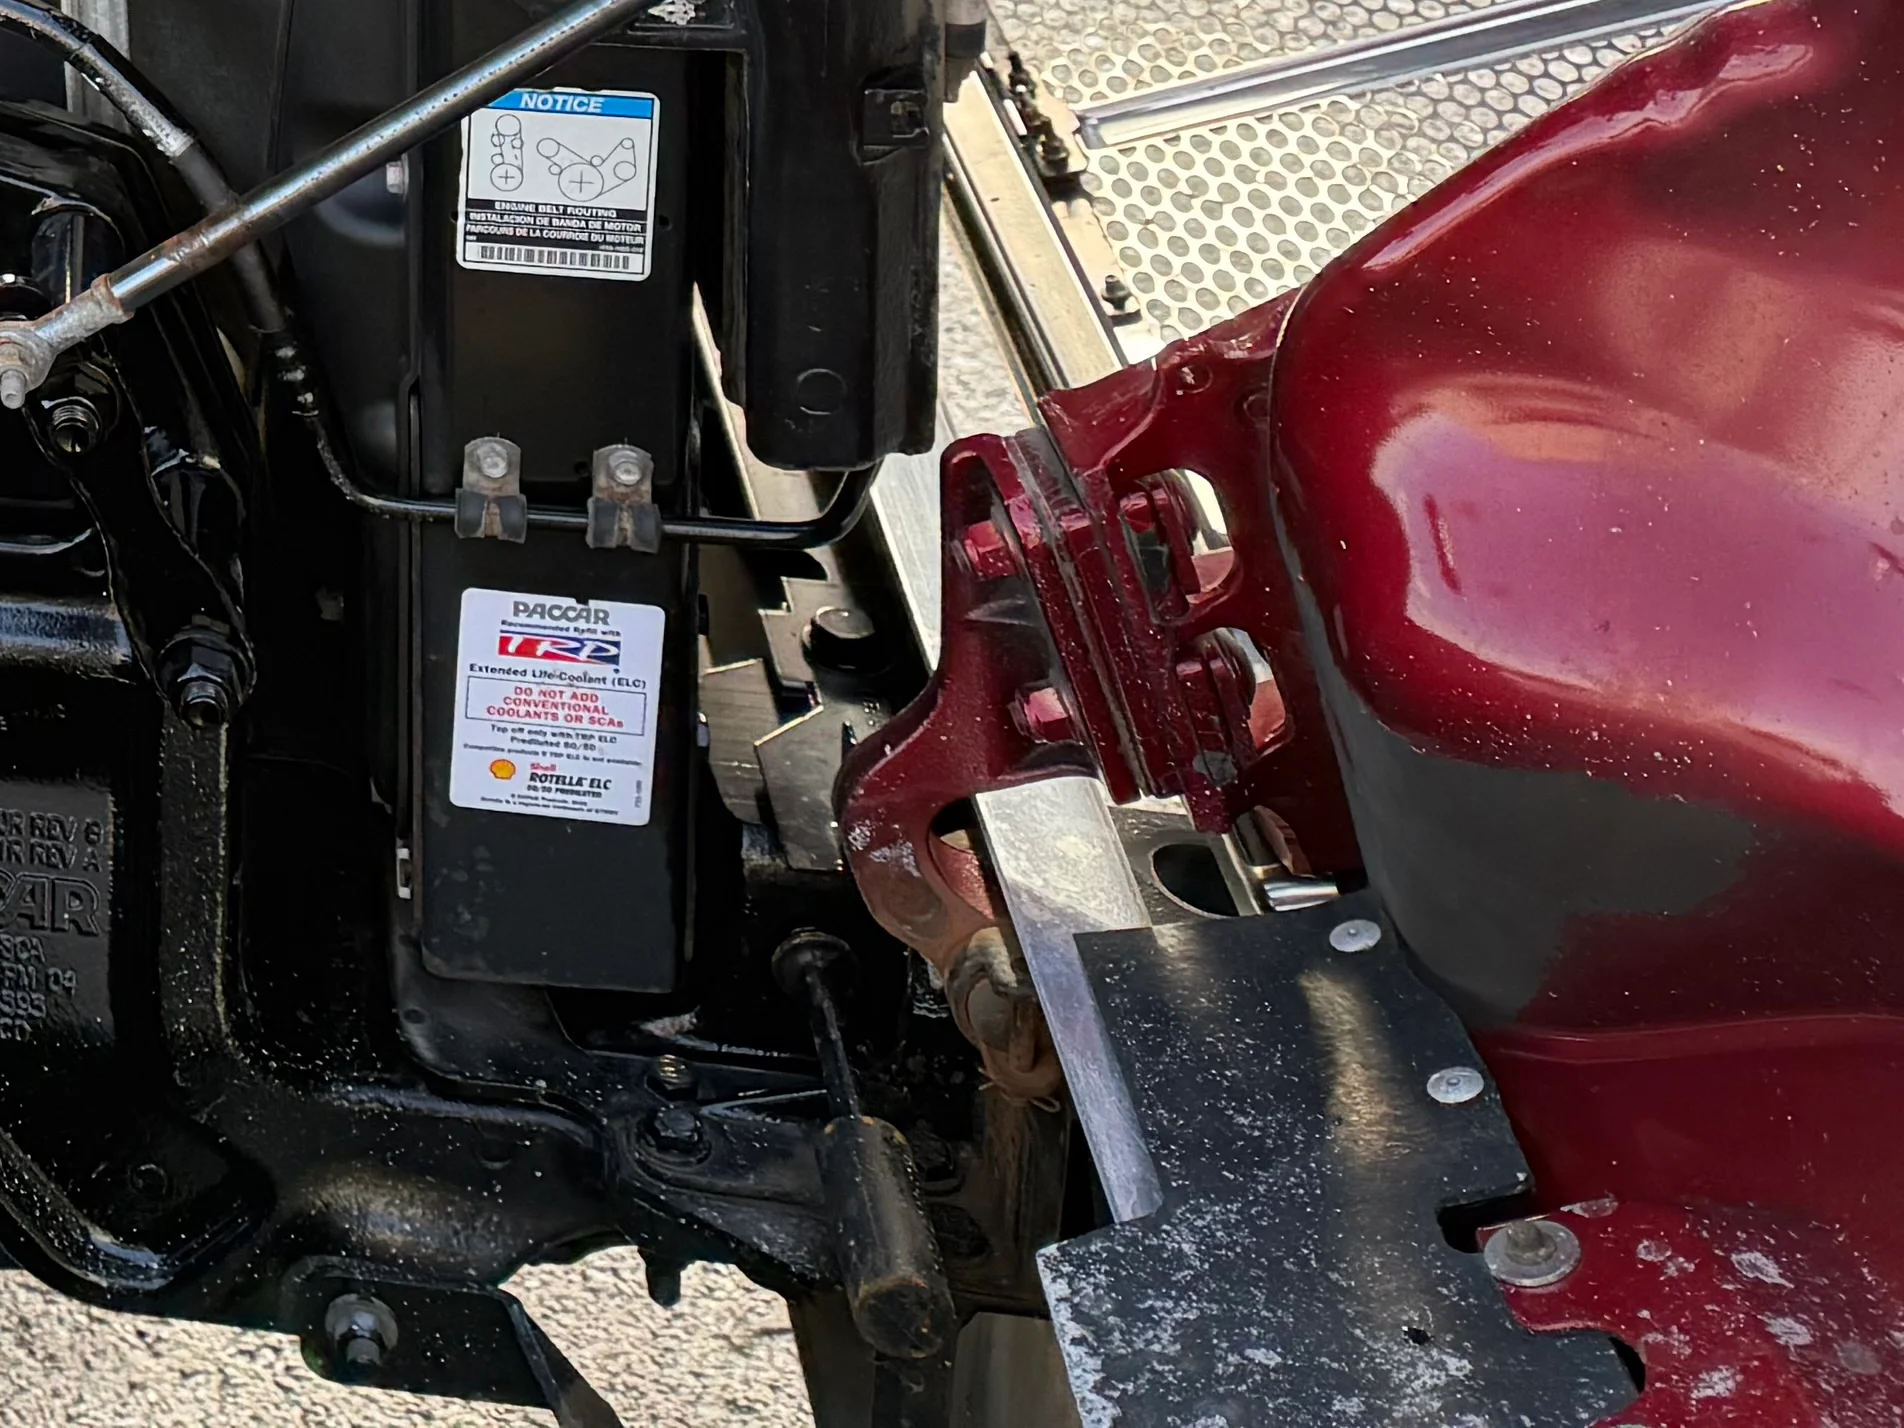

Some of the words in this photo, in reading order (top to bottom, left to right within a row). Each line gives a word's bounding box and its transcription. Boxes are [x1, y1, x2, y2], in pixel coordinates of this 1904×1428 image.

[519, 93, 605, 113] NOTICE
[495, 202, 536, 213] ENGINE
[539, 204, 565, 214] BELT
[567, 207, 616, 218] ROUTING
[536, 217, 550, 226] DE
[552, 218, 586, 228] BANDA
[589, 221, 602, 230] DE
[604, 222, 641, 232] MOTOR
[466, 225, 514, 235] PARCOURS
[515, 227, 528, 237] DE
[530, 229, 541, 237] LA
[543, 230, 589, 241] COURROIE
[591, 232, 604, 241] DU
[606, 234, 644, 244] MOTEUR
[513, 601, 610, 626] PACCAR
[501, 619, 570, 632] Recommended
[573, 626, 598, 636] Refill
[601, 629, 621, 637] with
[502, 635, 620, 658] TRP
[469, 663, 527, 677] Extended
[612, 678, 647, 689] (ELC)
[514, 686, 533, 696] DO
[539, 689, 565, 699] NOT
[571, 691, 599, 703] ADD
[504, 697, 609, 715] CONVENTIONAL
[487, 706, 559, 722] COOLANTS
[564, 714, 583, 724] OR
[588, 717, 624, 728] SCAs
[491, 724, 509, 734] Top
[527, 728, 547, 738] only
[530, 762, 557, 772] Shell
[529, 772, 583, 787] ROTELLA
[589, 778, 612, 790] ELC
[30, 811, 78, 843] REV
[30, 838, 78, 870] REV
